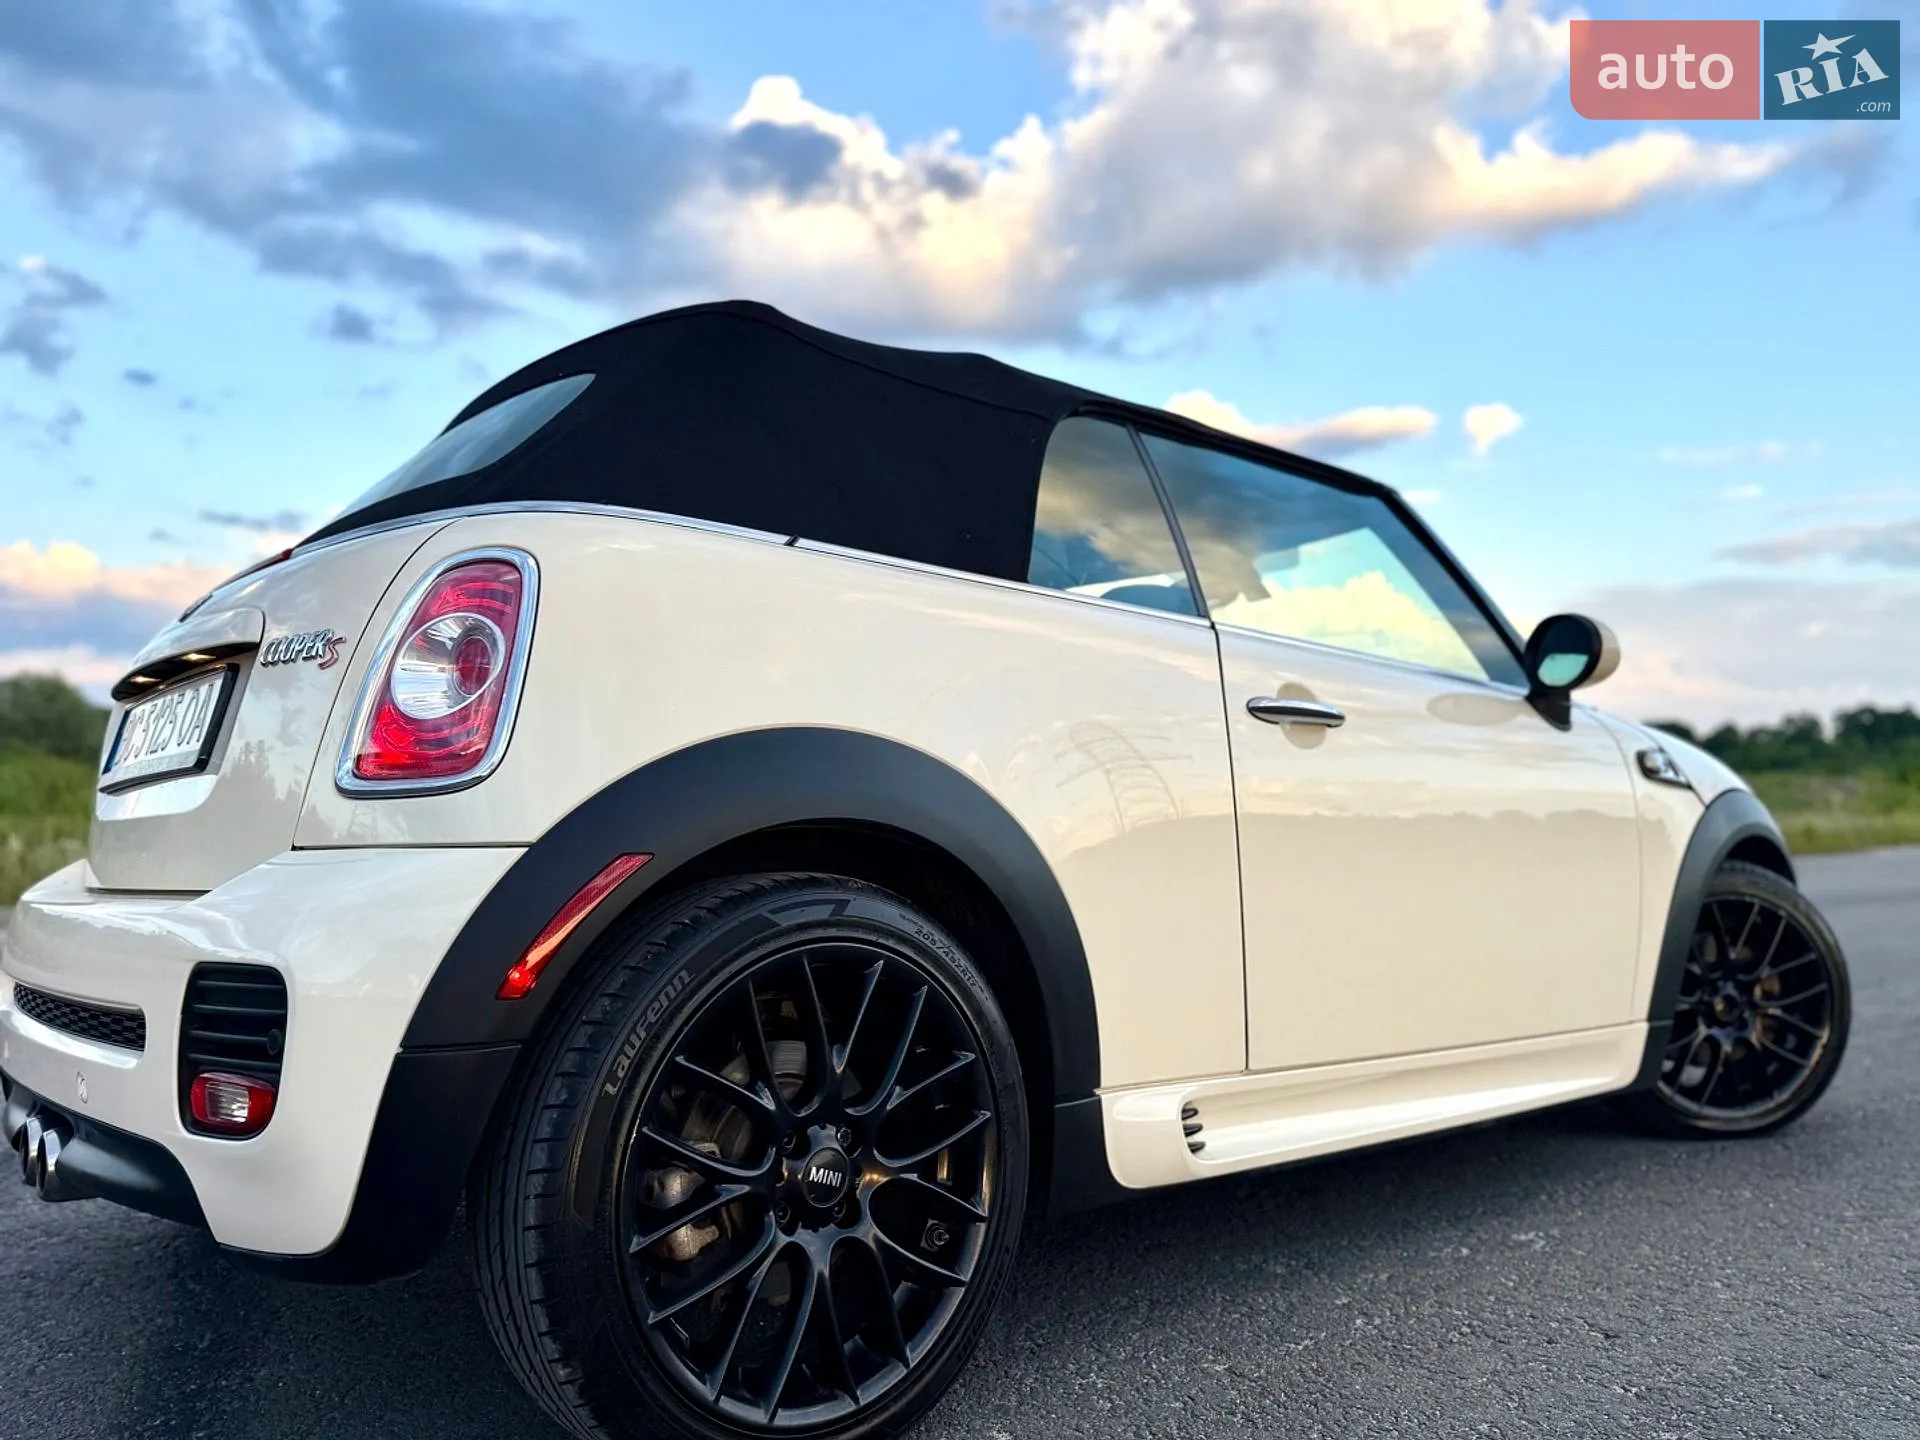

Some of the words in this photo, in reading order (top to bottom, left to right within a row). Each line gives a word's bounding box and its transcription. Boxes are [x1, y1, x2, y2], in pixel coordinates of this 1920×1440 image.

[260, 628, 334, 668] COOPER
[319, 637, 347, 670] S
[809, 1166, 842, 1187] MINI
